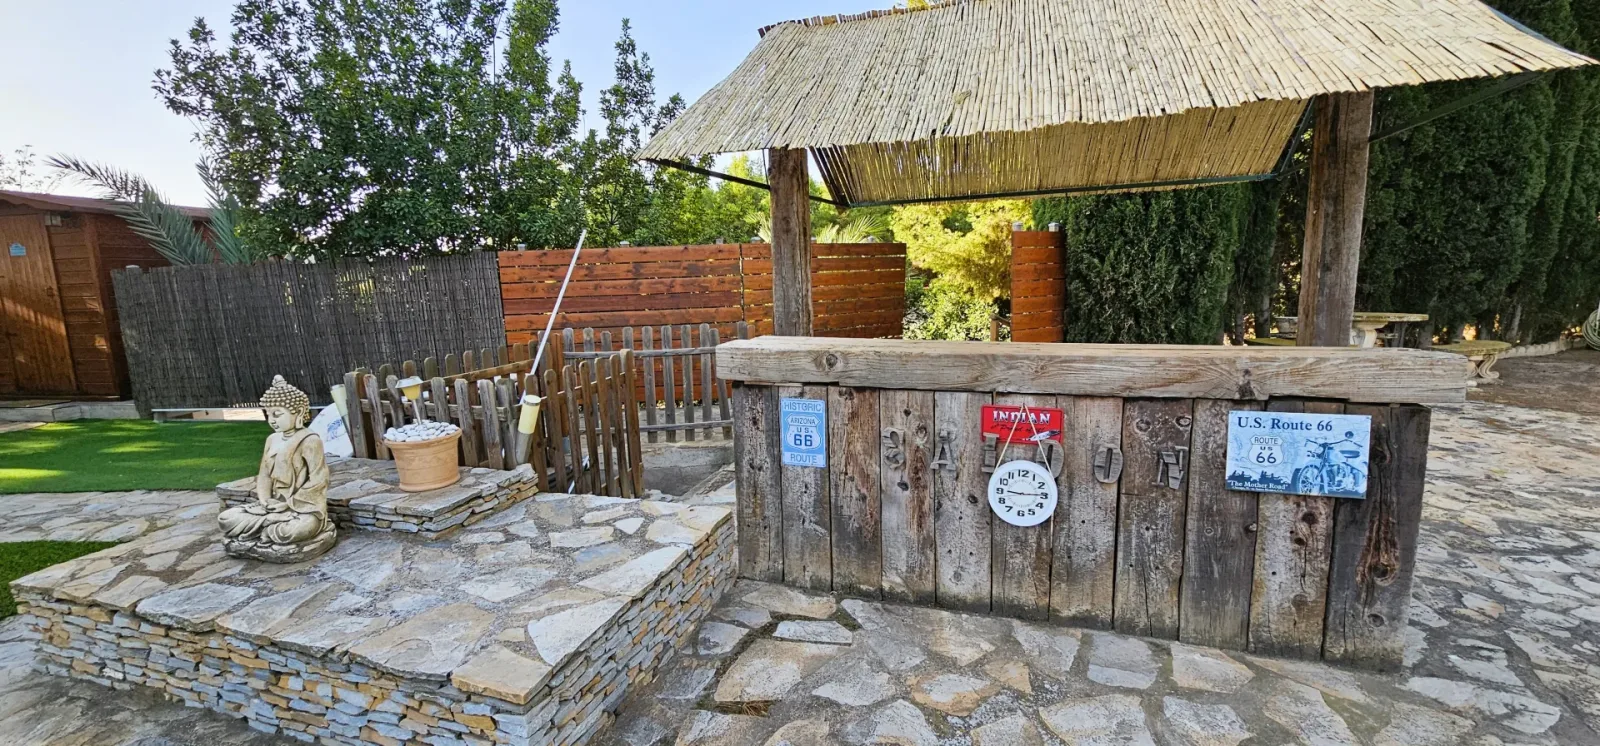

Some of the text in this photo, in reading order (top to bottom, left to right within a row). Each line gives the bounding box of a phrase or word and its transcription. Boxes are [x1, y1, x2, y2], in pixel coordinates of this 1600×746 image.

[784, 401, 822, 412] HISTORIC
[790, 416, 816, 425] ARIZONA
[993, 410, 1051, 425] INDIAN
[1237, 416, 1333, 432] U.S. Route 66
[793, 434, 813, 447] 66
[1254, 436, 1279, 445] ROUTE
[790, 453, 818, 464] ROUTE
[1256, 452, 1277, 464] 66
[1008, 472, 1014, 480] 11
[1018, 469, 1029, 478] 12
[1032, 473, 1036, 481] 1
[999, 478, 1009, 486] 10
[1037, 481, 1045, 489] 2
[1244, 481, 1268, 489] Mother
[996, 487, 1004, 495] 9
[1040, 492, 1049, 500] 3
[998, 497, 1006, 505] 8
[1027, 508, 1036, 516] 5
